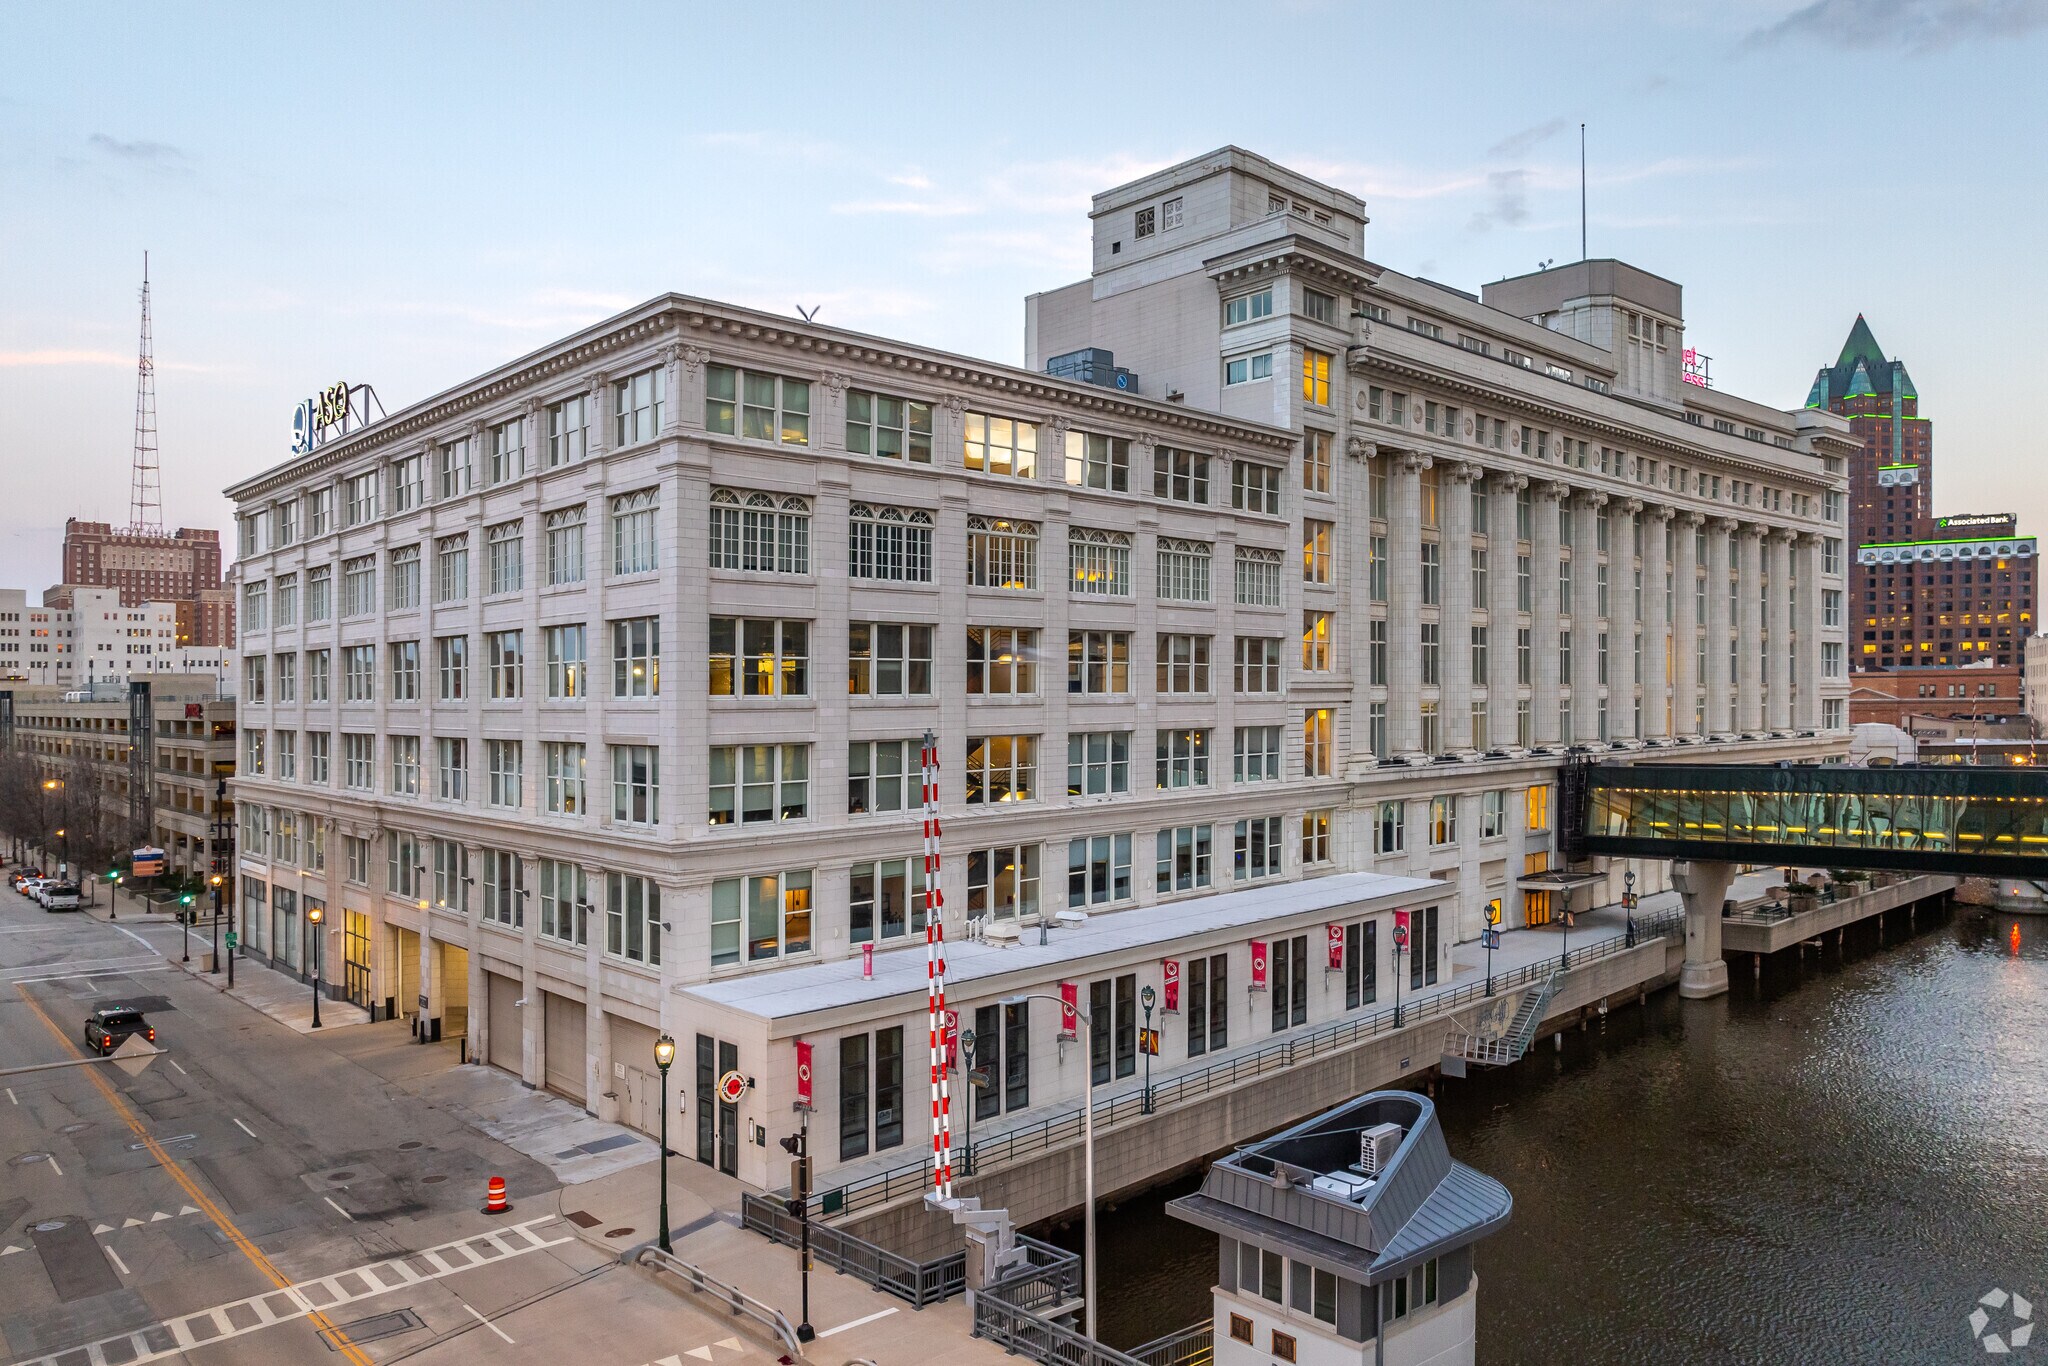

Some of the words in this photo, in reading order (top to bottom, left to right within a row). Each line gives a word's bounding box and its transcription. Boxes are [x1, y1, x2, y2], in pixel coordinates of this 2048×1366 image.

[316, 381, 350, 430] ASQ
[1948, 517, 1990, 526] Associated
[1991, 516, 2008, 524] Bank
